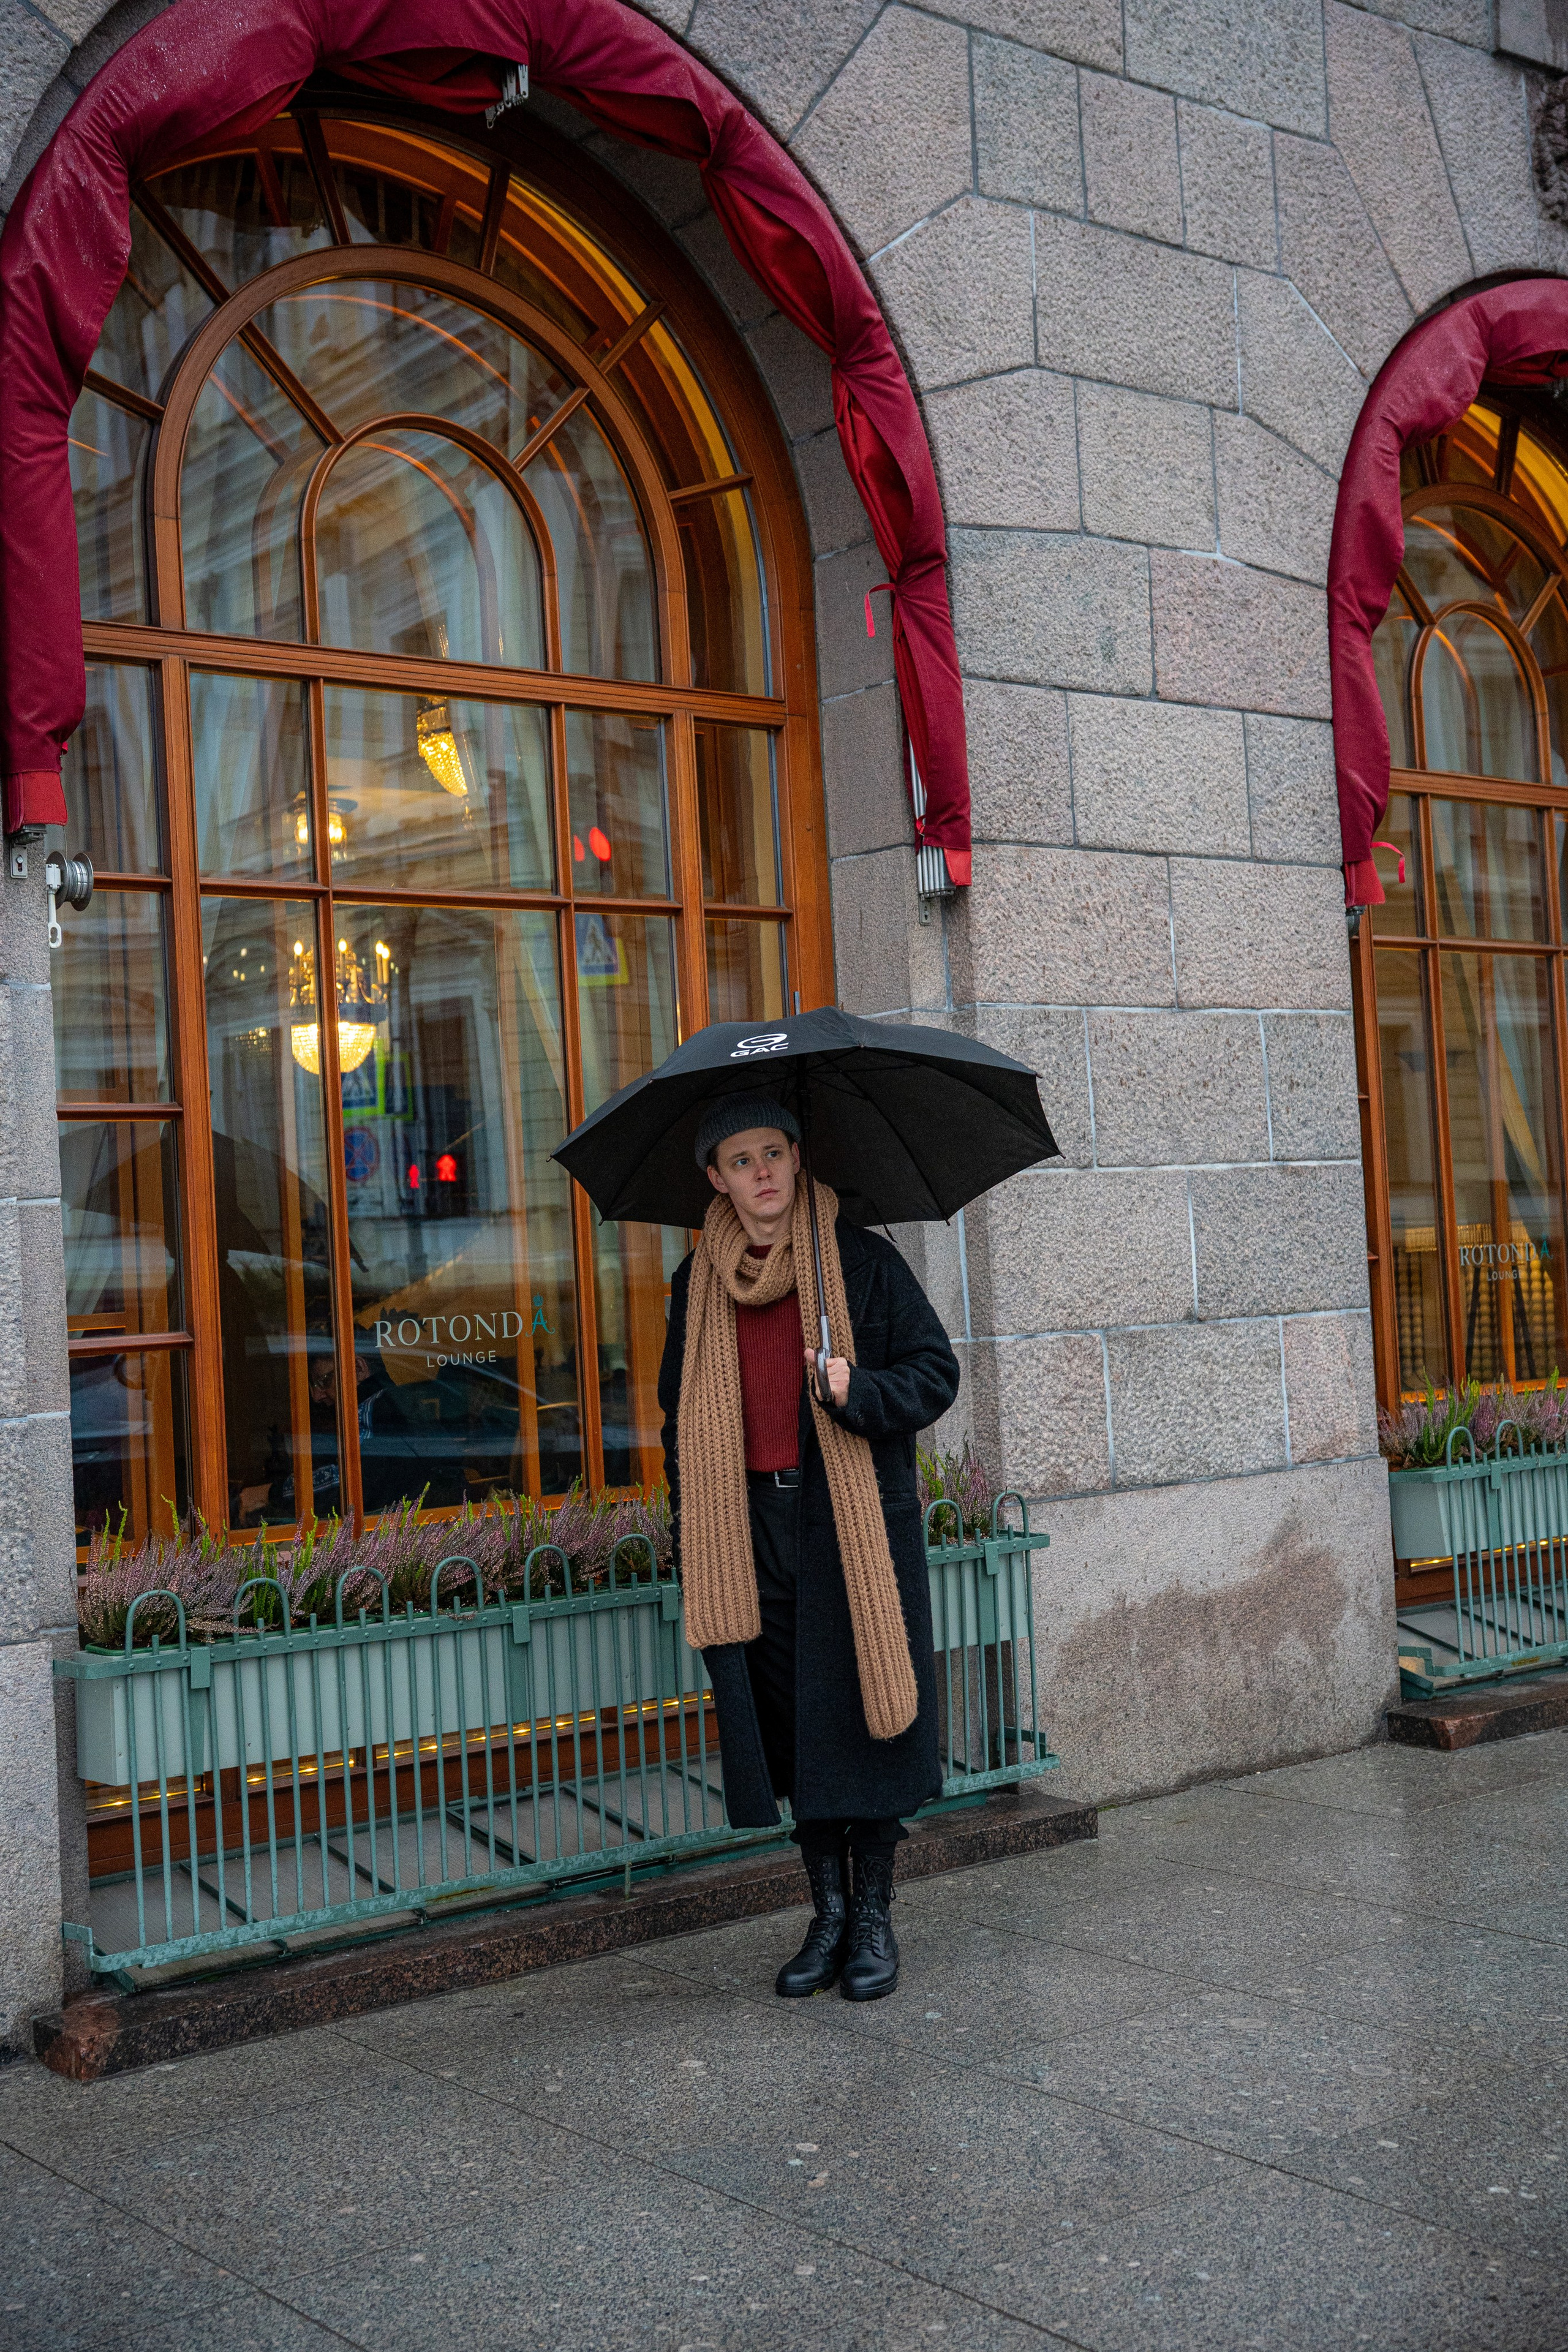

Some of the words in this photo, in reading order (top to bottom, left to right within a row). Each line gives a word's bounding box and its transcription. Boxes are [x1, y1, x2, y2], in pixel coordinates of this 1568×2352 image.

[730, 1042, 789, 1057] GAC
[374, 1308, 556, 1348] ROTONDA
[427, 1351, 497, 1368] LOUNGE
